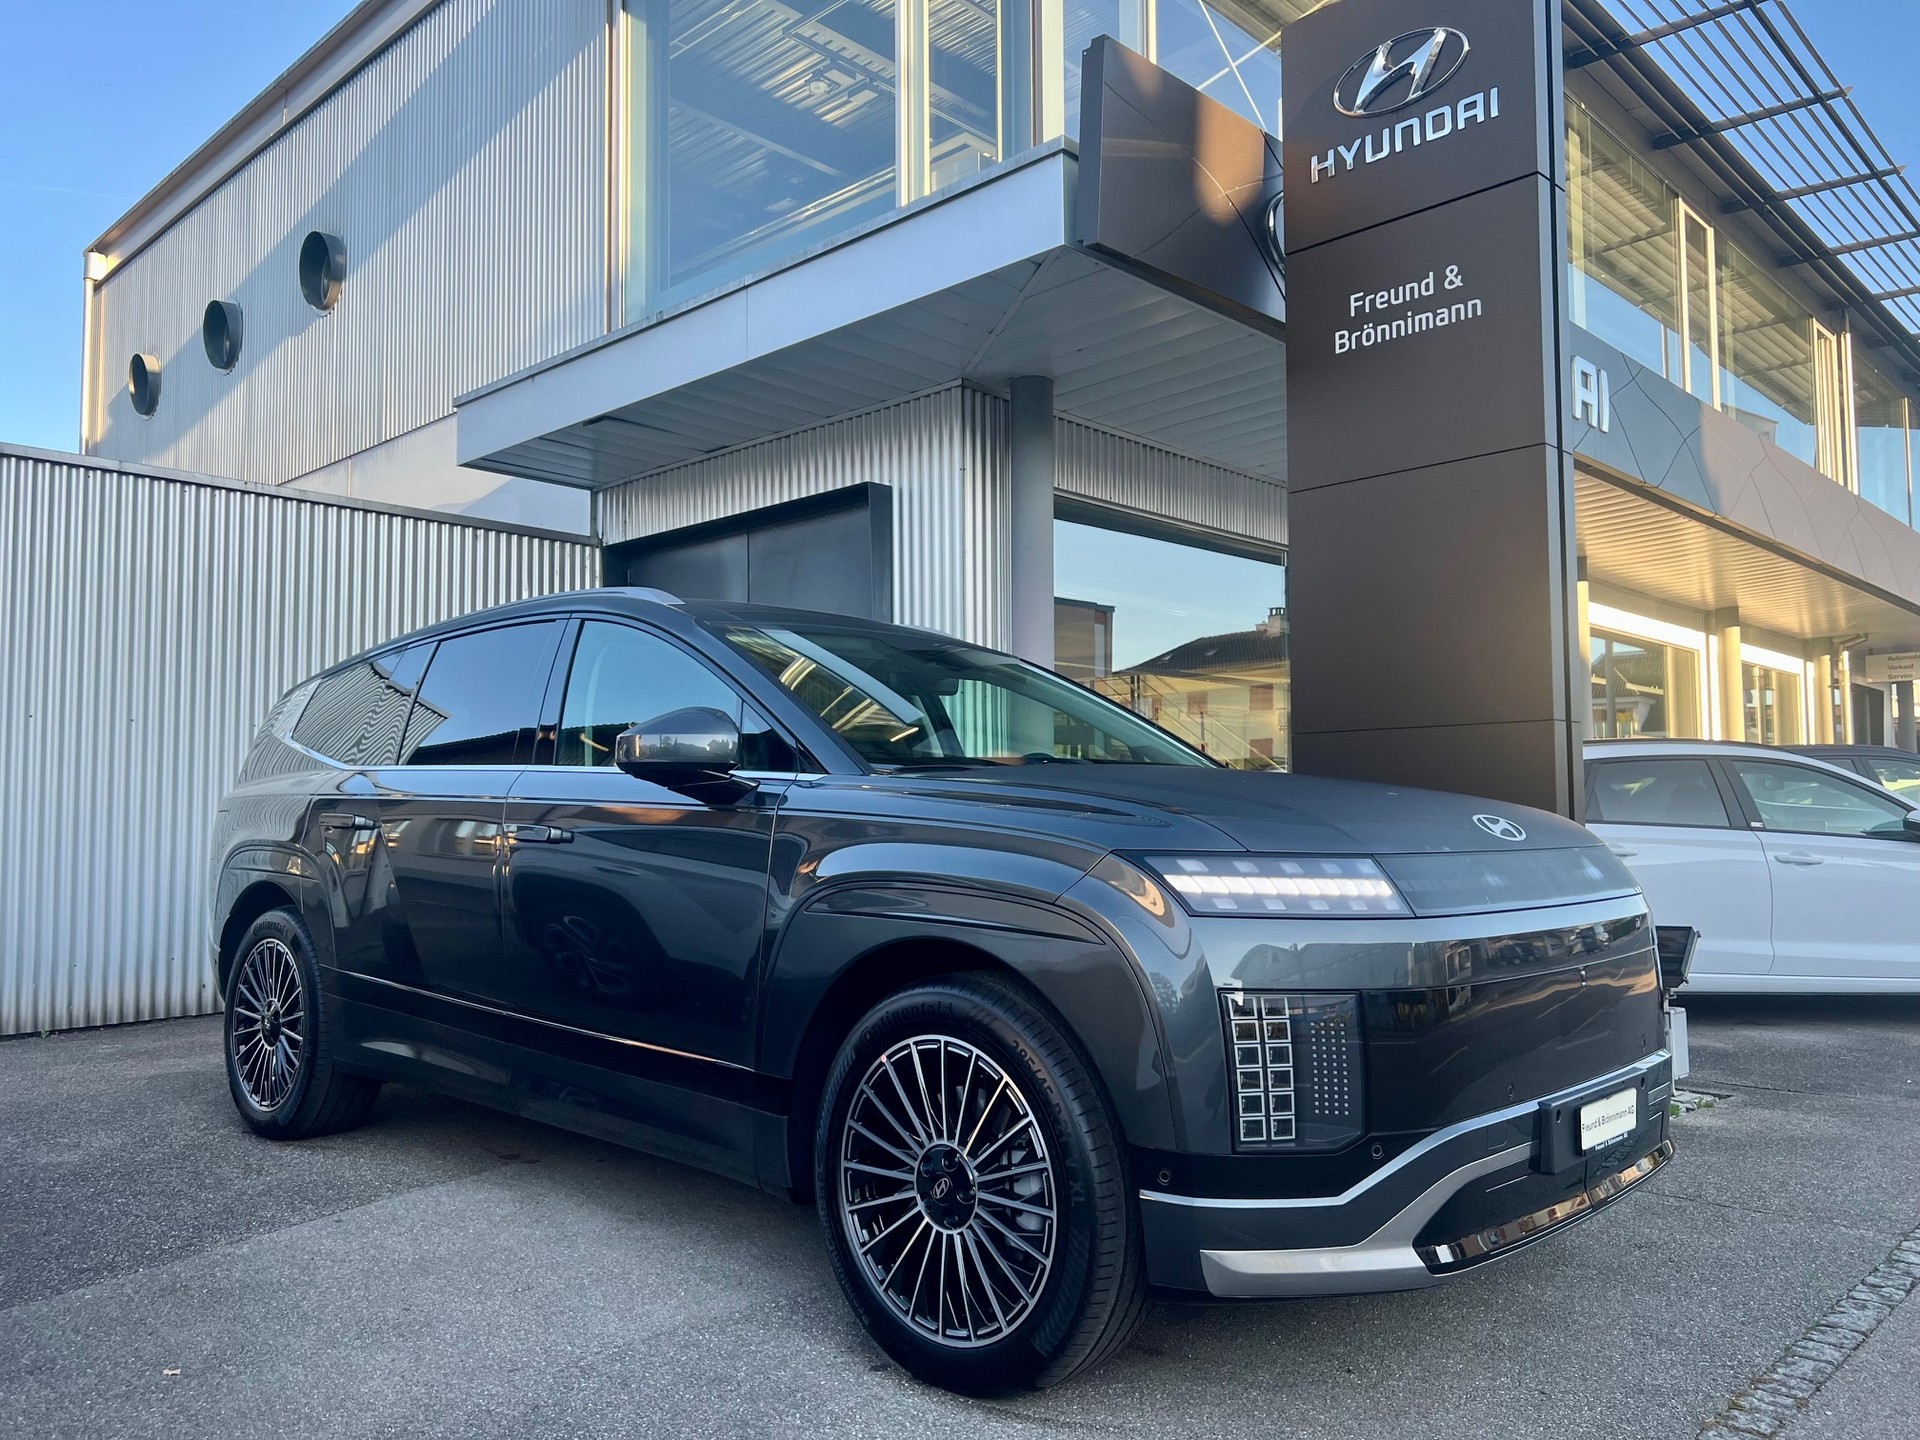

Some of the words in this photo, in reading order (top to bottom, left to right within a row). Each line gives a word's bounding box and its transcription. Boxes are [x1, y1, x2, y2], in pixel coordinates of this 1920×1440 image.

[1311, 86, 1499, 184] HYUNDAI
[1350, 271, 1434, 317] Freund
[1444, 264, 1464, 290] &
[1334, 298, 1482, 354] Brönnimann
[859, 1000, 941, 1050] Continental
[1582, 1119, 1597, 1131] Freund
